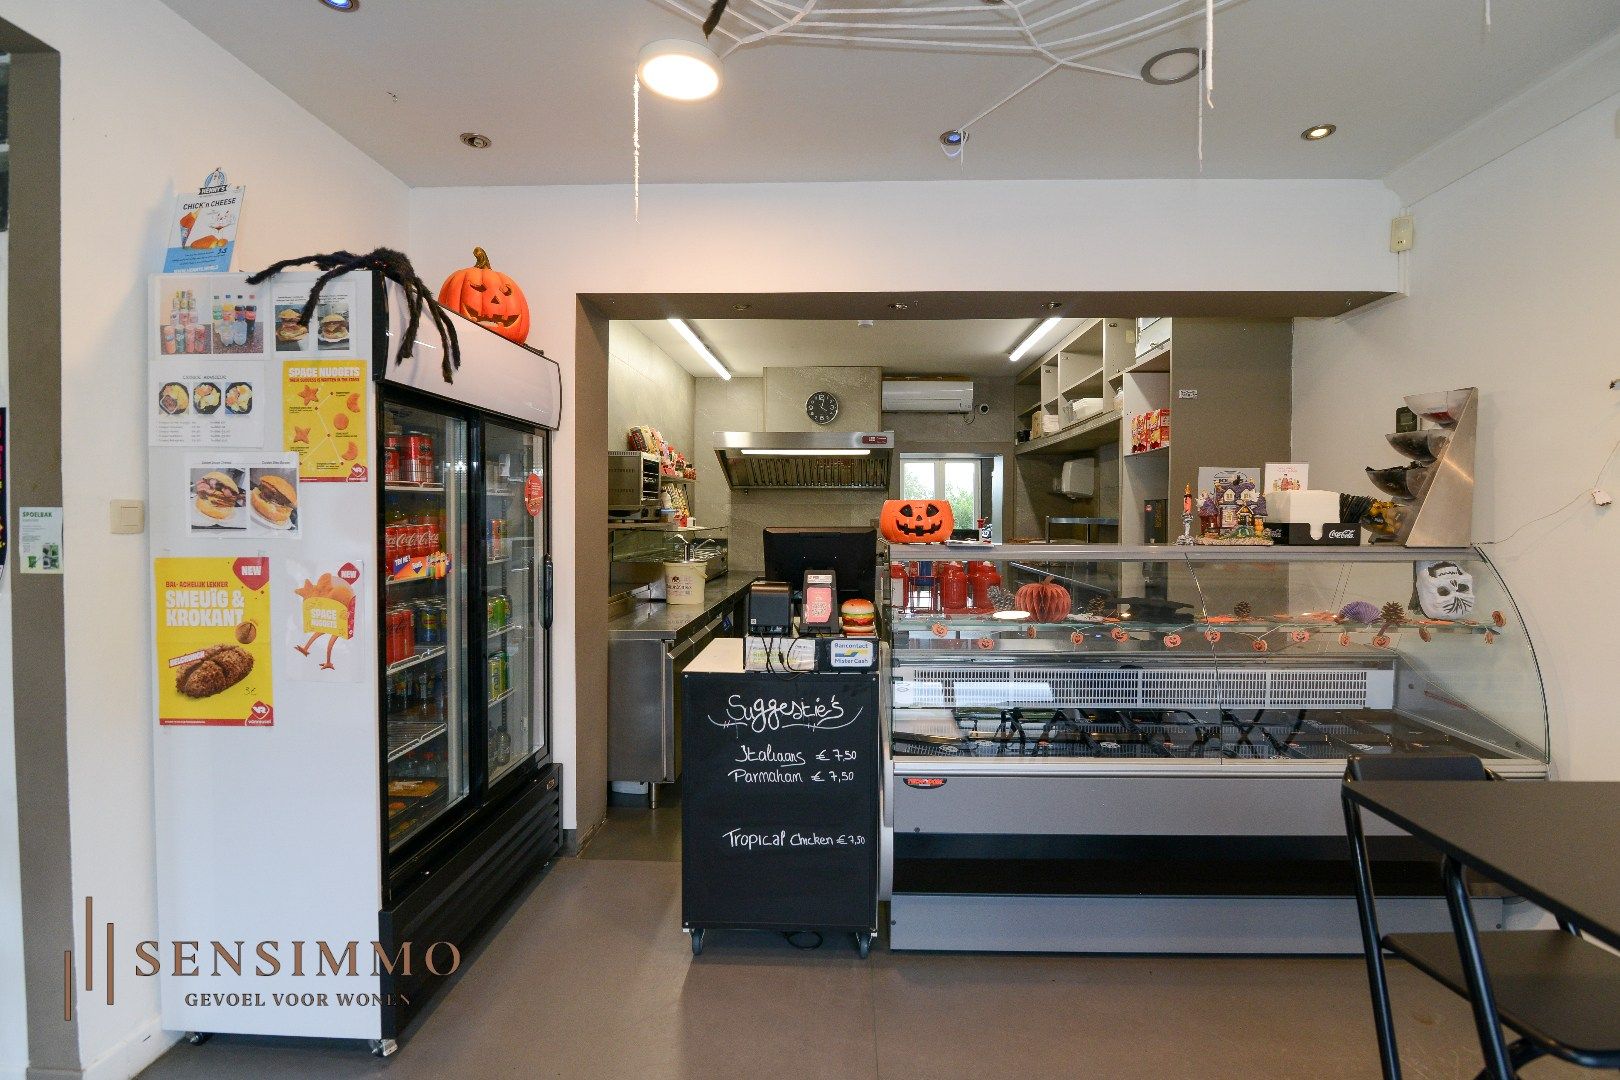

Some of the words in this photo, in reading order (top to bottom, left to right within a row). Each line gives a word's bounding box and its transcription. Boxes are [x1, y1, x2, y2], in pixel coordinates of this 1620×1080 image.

[183, 202, 204, 210] CHICK
[210, 197, 236, 207] CHEESE
[289, 367, 318, 377] SPACE
[320, 366, 360, 377] NUGGETS
[395, 557, 403, 567] TRY
[241, 565, 262, 576] NEW
[340, 570, 358, 578] NEW
[166, 588, 229, 608] SMEUÏG
[232, 590, 245, 608] &
[167, 608, 244, 627] KROKANT
[311, 608, 337, 620] SPACE
[834, 642, 869, 650] Bancontact
[725, 694, 844, 734] Suggestie's
[735, 744, 807, 767] Italiaans
[815, 749, 831, 761] €
[832, 749, 857, 762] 7,50
[811, 771, 825, 782] €
[829, 771, 854, 783] 7,50
[722, 828, 785, 850] Tropical
[790, 833, 834, 846] Chicken
[848, 835, 866, 846] 7,50
